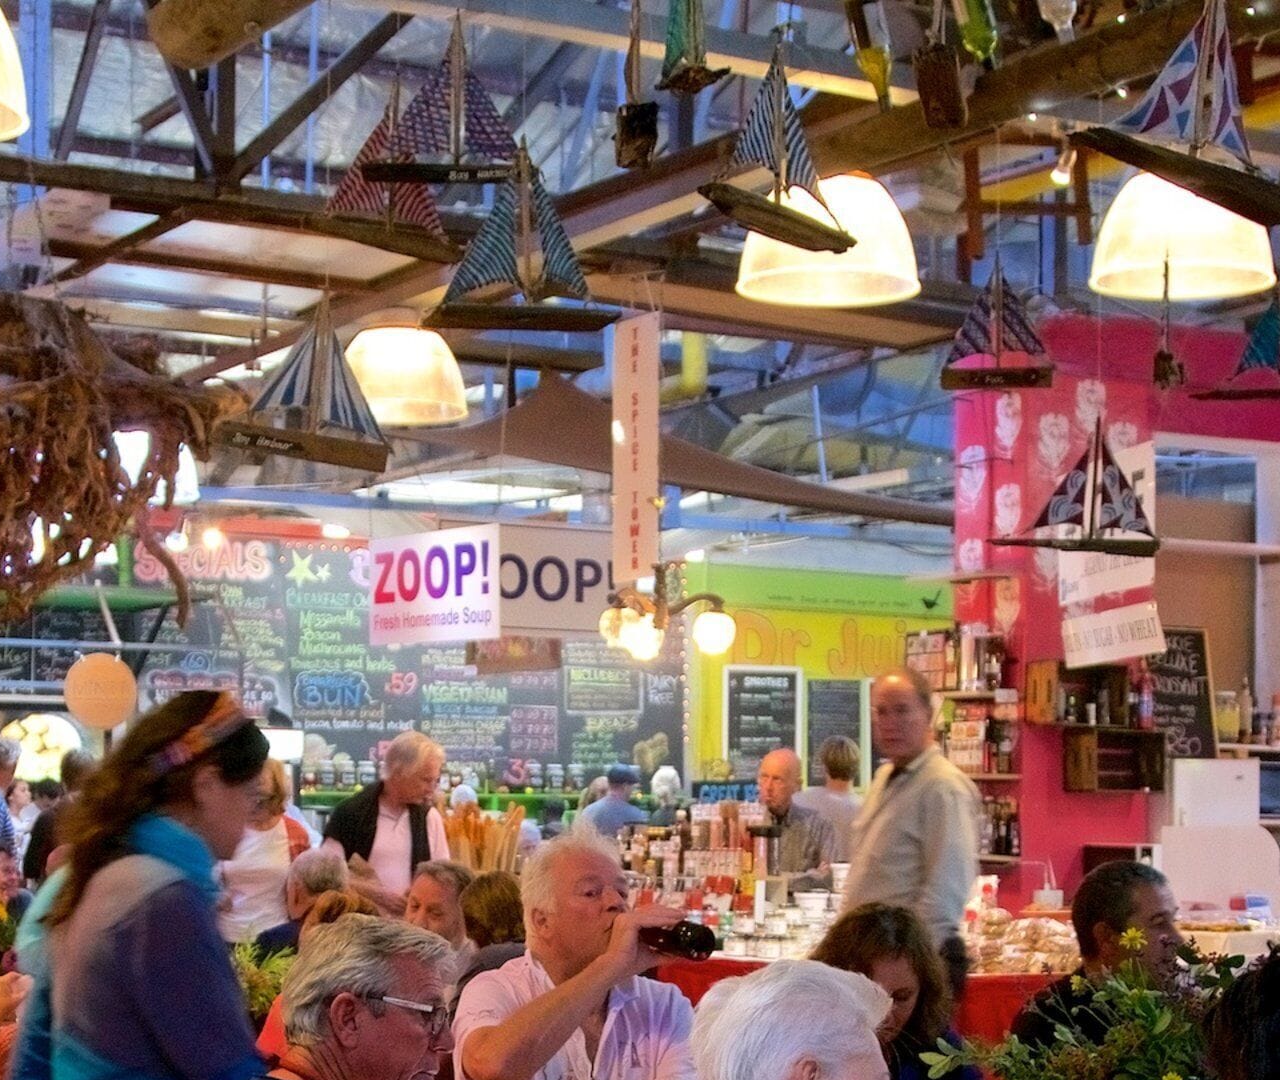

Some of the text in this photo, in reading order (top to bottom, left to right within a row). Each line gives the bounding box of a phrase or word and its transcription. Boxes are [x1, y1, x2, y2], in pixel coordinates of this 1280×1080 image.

[629, 327, 640, 570] THE SPICE TOWER
[373, 540, 490, 604] ZOOP!
[501, 553, 615, 605] OOP!
[286, 587, 350, 606] BREAKFAST
[373, 606, 492, 630] Fresh Homemade Soup
[300, 628, 341, 641] Bacon
[732, 608, 907, 676] Dr Jui
[422, 683, 508, 704] VEGETARIAN
[743, 676, 789, 688] SMOOTHIES
[302, 685, 362, 707] BUN
